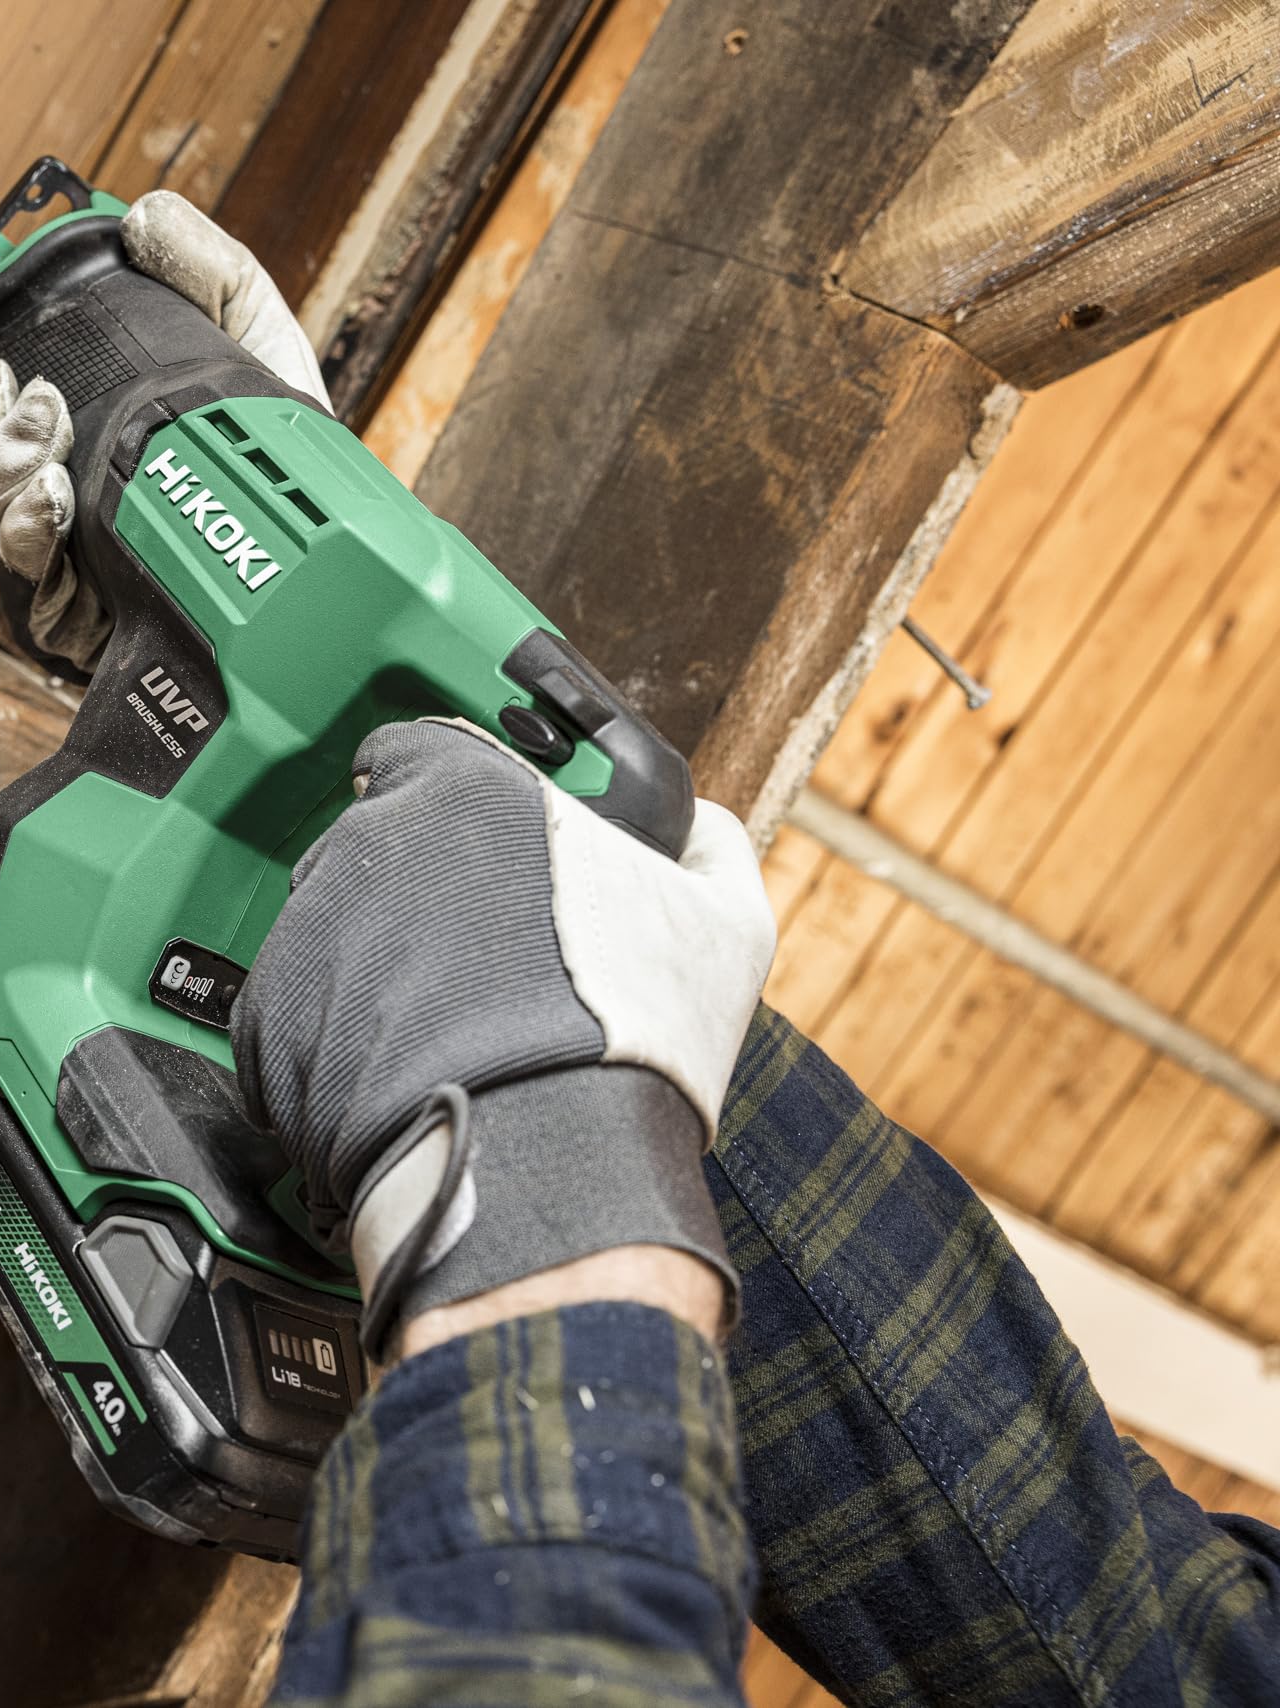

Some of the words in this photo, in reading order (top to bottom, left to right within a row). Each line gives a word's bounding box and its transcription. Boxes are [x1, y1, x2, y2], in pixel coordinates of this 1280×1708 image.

[144, 447, 283, 591] HiKOKI
[125, 692, 187, 759] BRUSHLESS
[140, 666, 210, 732] UVP
[13, 1241, 73, 1331] HiKOKI
